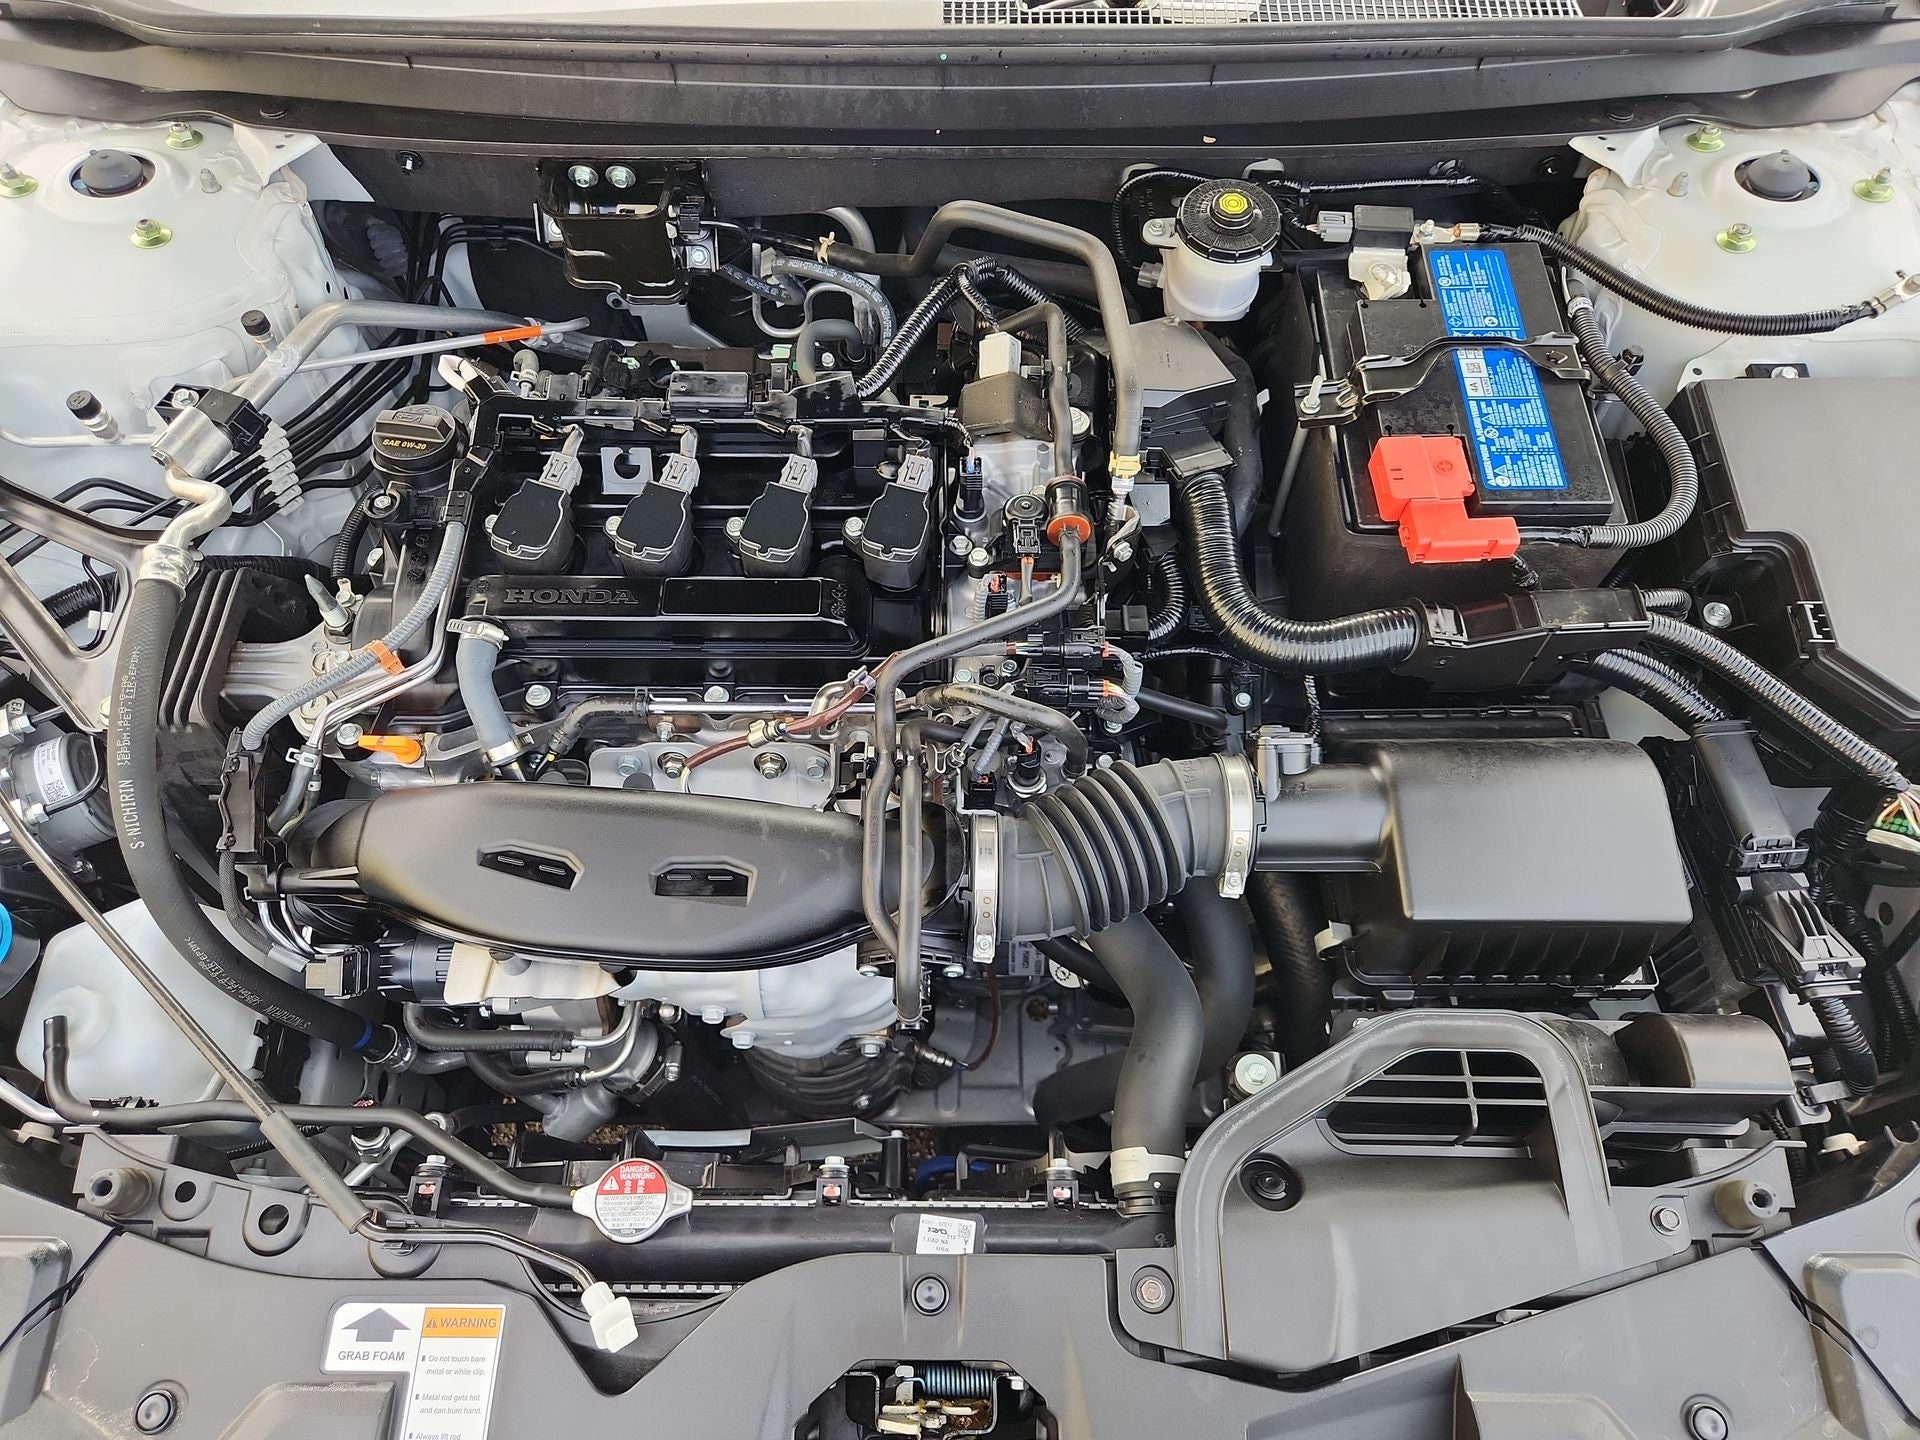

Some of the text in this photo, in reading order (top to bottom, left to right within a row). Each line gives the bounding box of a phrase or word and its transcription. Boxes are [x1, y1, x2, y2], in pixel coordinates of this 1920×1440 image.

[504, 588, 639, 604] HONDA
[620, 1165, 650, 1173] DANGER
[620, 1172, 656, 1180] WARNUNG
[440, 1318, 497, 1328] WARNING
[338, 1351, 405, 1361] GRAB FOAM
[472, 1368, 486, 1376] clip.
